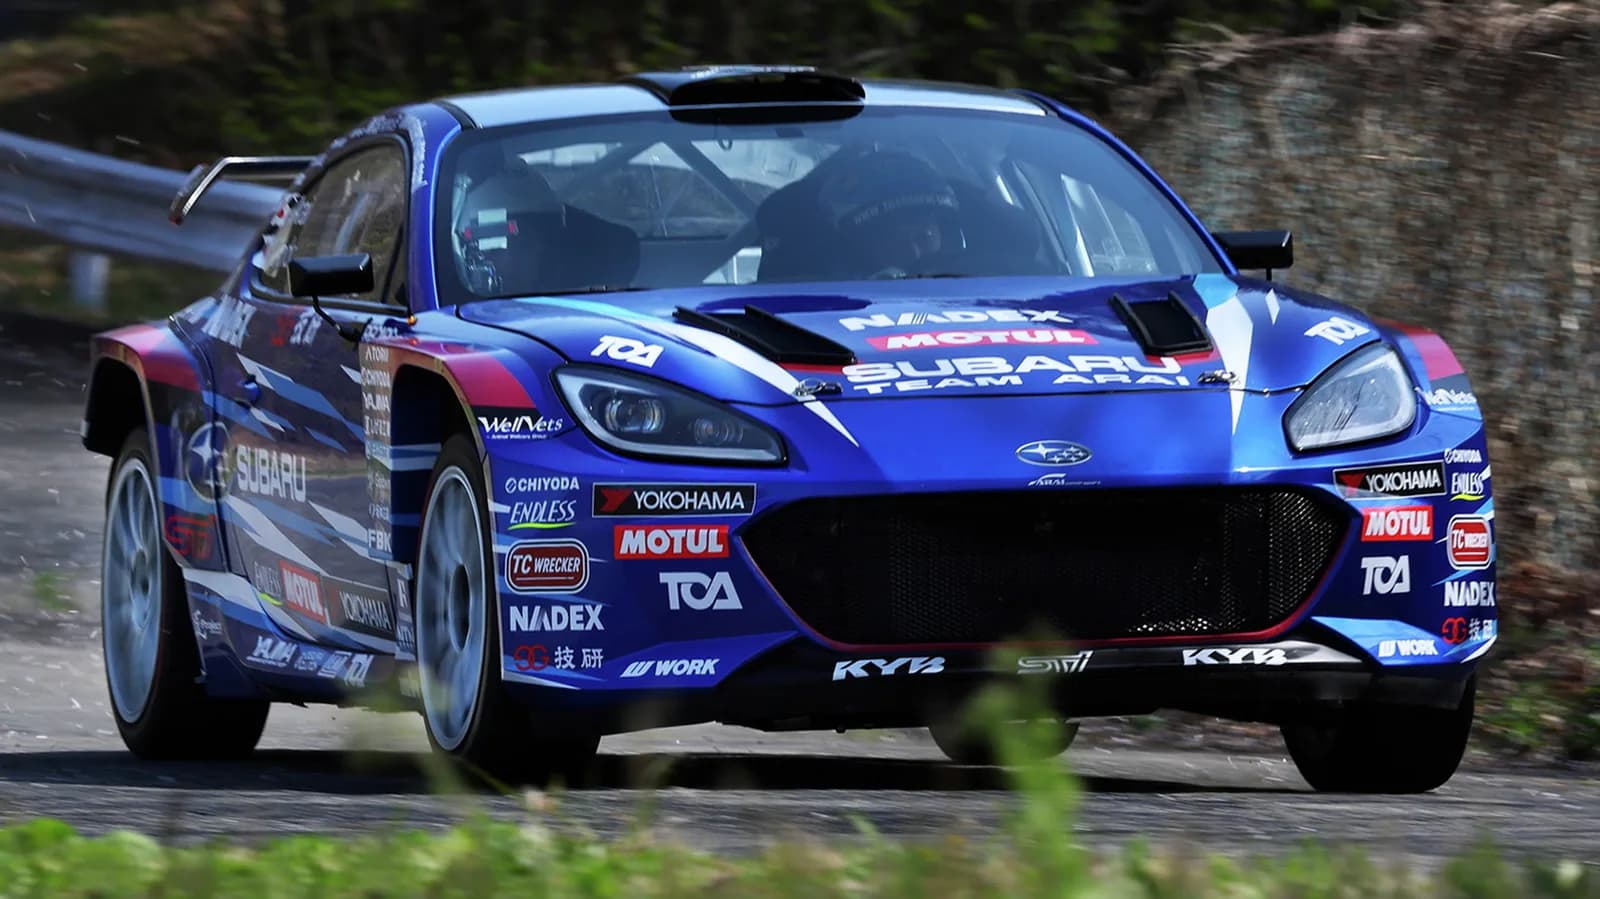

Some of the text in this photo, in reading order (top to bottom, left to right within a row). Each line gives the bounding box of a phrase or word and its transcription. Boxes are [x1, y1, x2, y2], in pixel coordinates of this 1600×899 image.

[839, 310, 1073, 331] NADEX
[590, 335, 665, 368] TOA
[887, 330, 1087, 349] MOTUL
[842, 355, 1182, 383] SUBARU
[854, 374, 1190, 395] TEAM ARAI
[478, 415, 563, 433] WellVets
[236, 445, 306, 503] SUBARU
[517, 477, 580, 492] CHIYODA
[1366, 469, 1442, 492] YOKOHAMA
[510, 500, 577, 524] ENDLESS
[633, 490, 745, 511] YOKOHAMA
[1365, 510, 1432, 537] MOTUL
[620, 528, 724, 555] MOTUL
[512, 554, 582, 574] TC WRECKER
[1361, 555, 1411, 595] TOA
[659, 571, 743, 610] TOA
[1444, 581, 1496, 607] NADEX
[510, 605, 605, 632] NADEX
[554, 645, 604, 669] 技研
[655, 658, 720, 676] WORK
[832, 657, 946, 681] KYB
[1182, 649, 1288, 666] KYB
